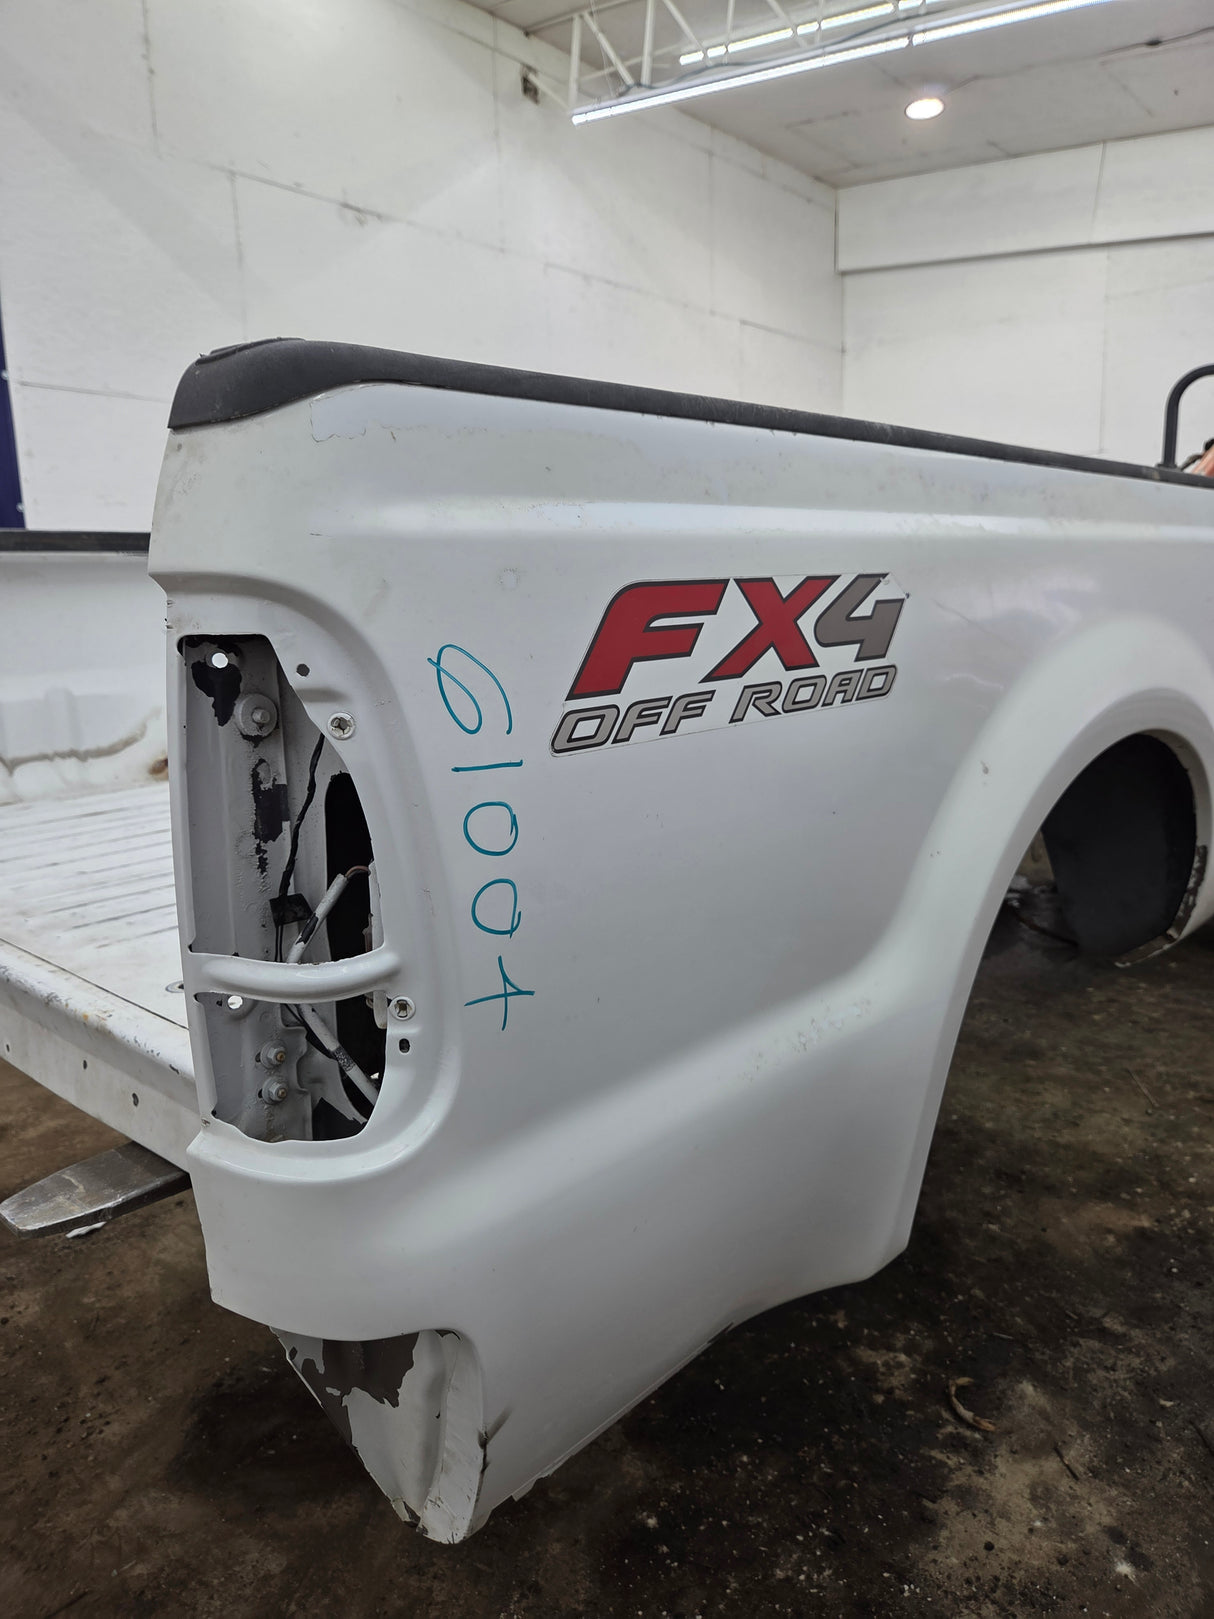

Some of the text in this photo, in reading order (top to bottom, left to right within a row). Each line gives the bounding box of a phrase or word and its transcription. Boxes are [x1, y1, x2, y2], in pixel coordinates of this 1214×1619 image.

[565, 573, 905, 701] FX4
[551, 664, 897, 754] OFF ROAD
